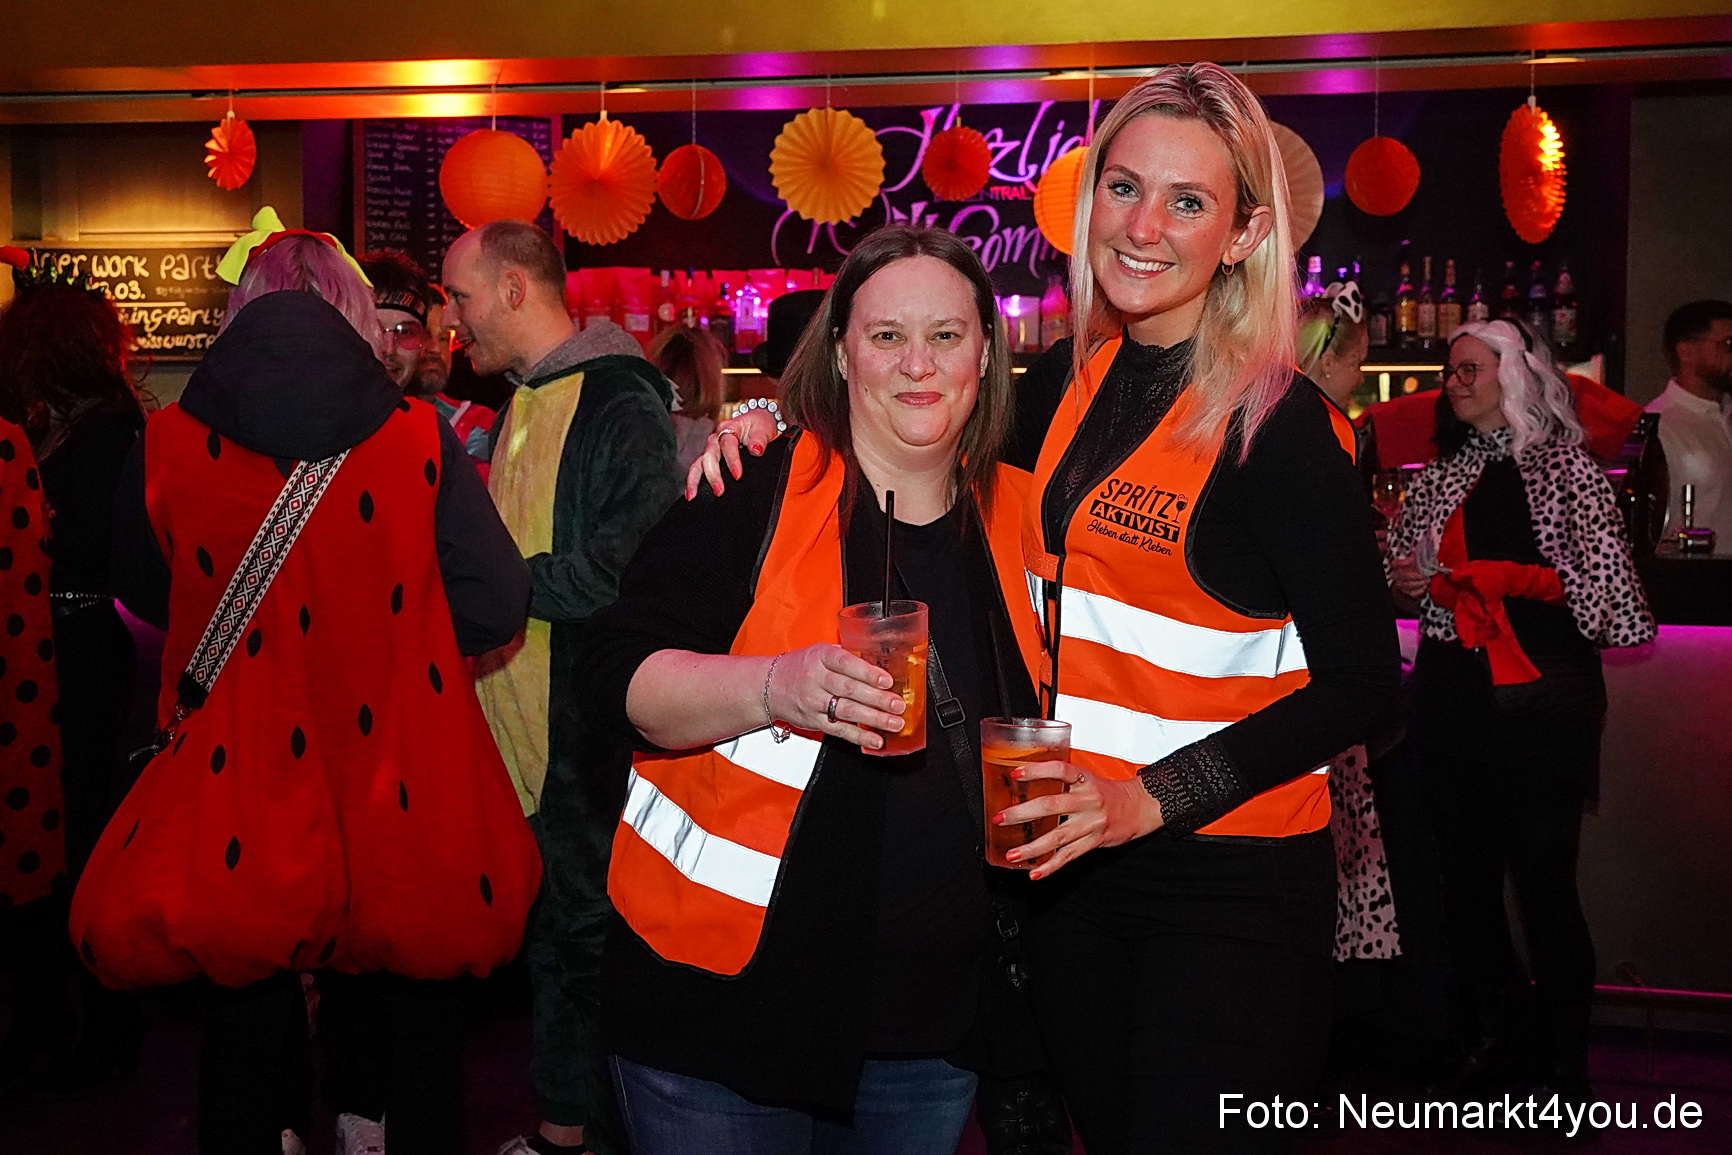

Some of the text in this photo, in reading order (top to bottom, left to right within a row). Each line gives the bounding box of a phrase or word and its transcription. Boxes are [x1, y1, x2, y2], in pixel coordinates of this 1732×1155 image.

[1100, 478, 1177, 520] SPRITZ
[1086, 519, 1173, 556] Heben statt Kleben
[1091, 501, 1179, 541] AKTIVIST
